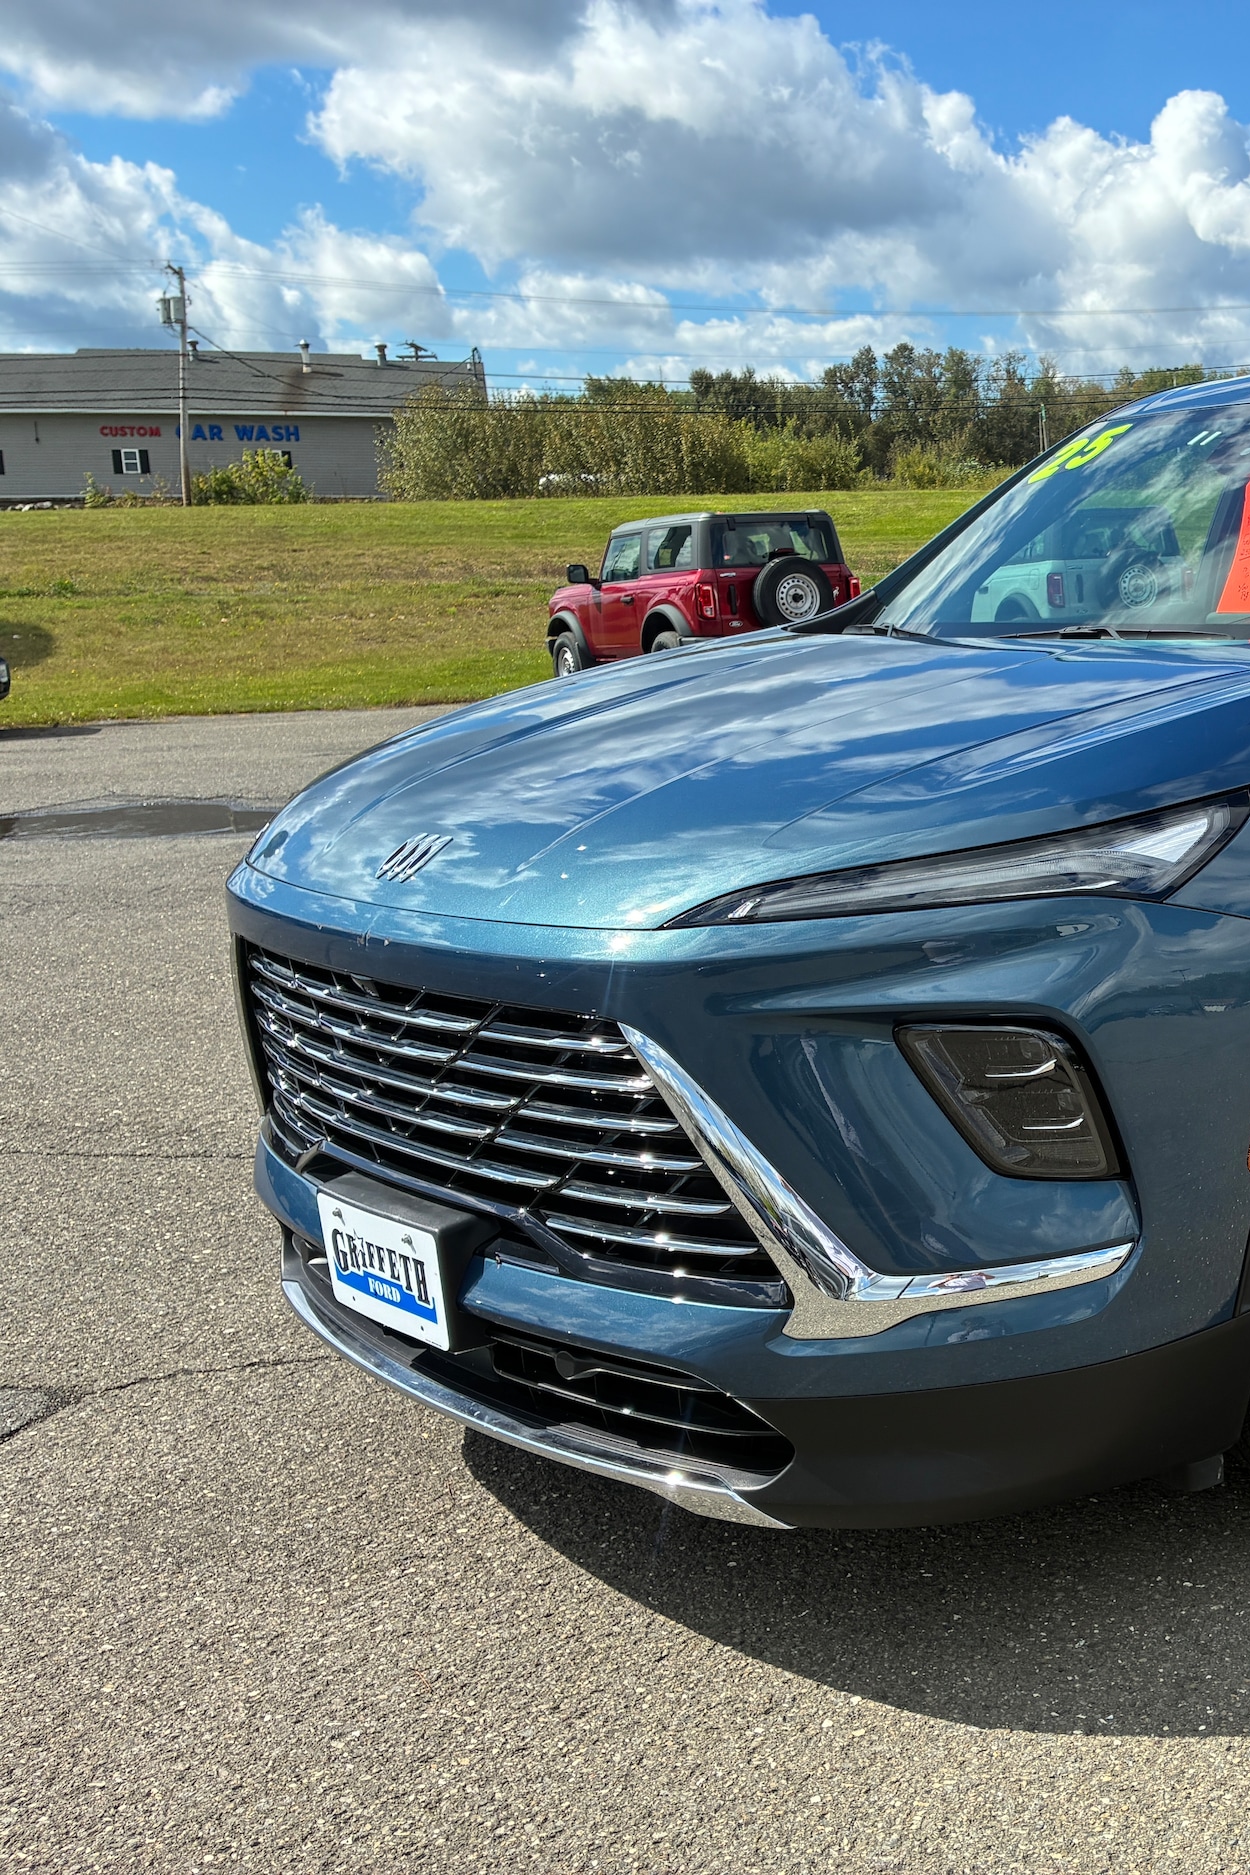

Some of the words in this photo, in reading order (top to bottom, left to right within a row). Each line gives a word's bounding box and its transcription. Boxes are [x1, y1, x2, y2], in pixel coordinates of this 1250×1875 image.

[99, 425, 161, 437] CUSTOM
[234, 424, 300, 442] WASH
[1028, 423, 1134, 484] 25
[332, 1228, 431, 1306] GRIFFETH
[368, 1277, 401, 1304] FORD
